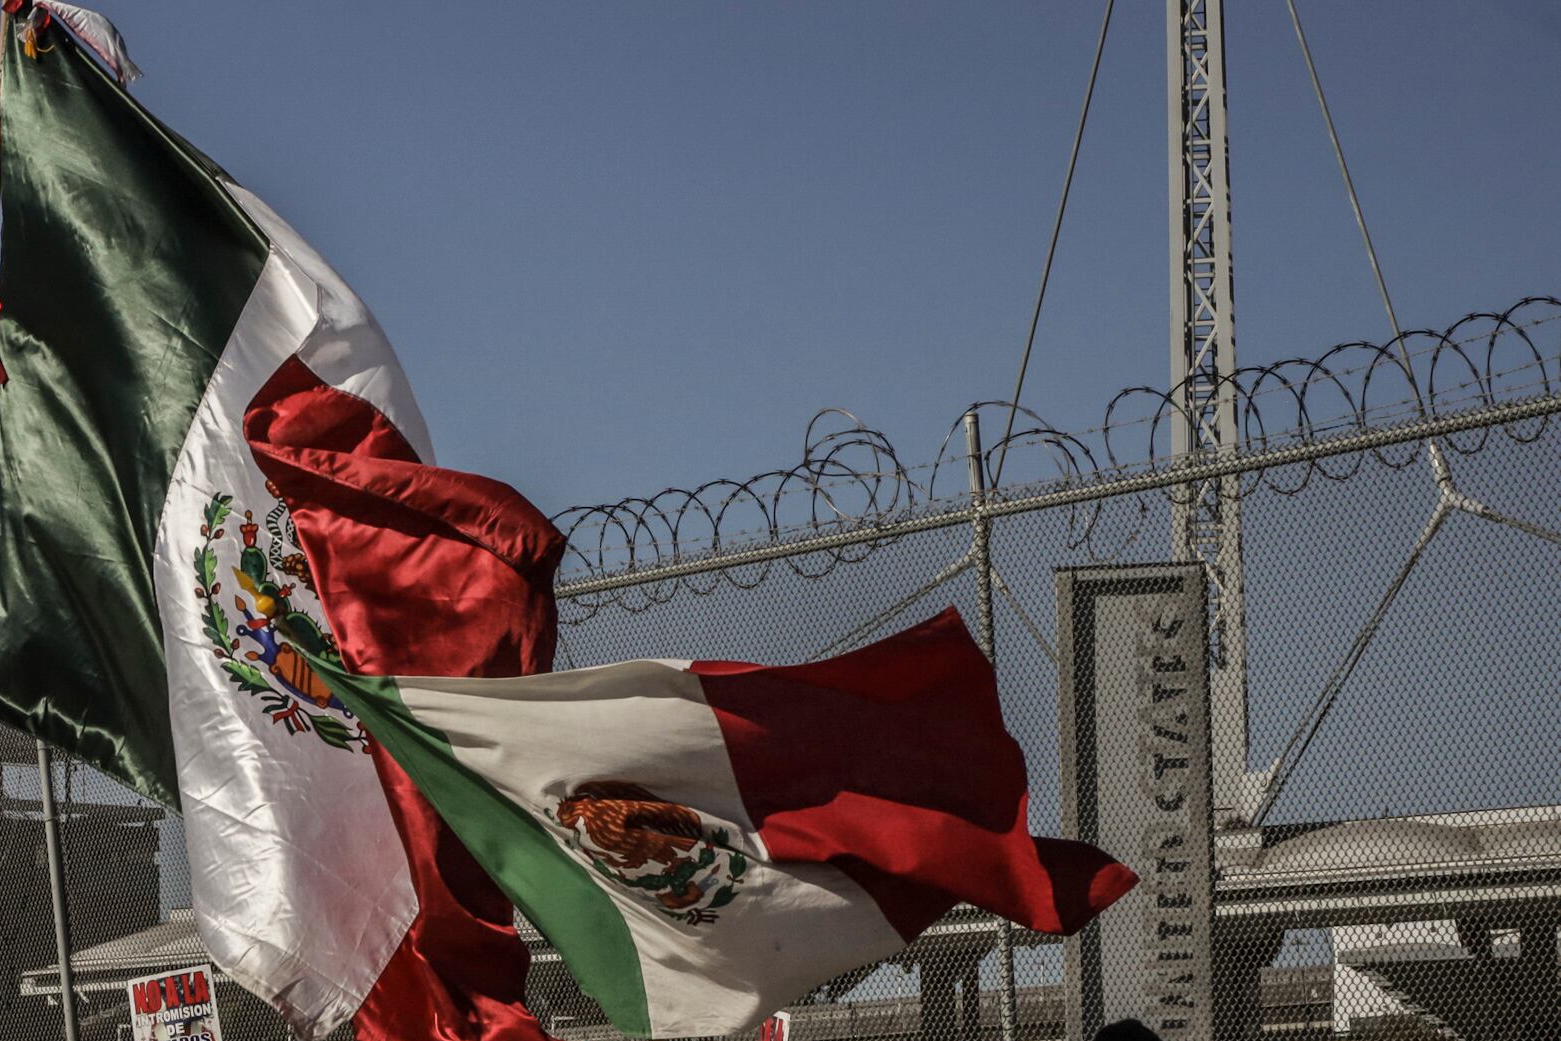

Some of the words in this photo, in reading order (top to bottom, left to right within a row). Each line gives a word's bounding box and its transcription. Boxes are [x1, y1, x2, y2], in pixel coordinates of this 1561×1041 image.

[133, 980, 162, 1014] NO
[181, 971, 210, 1004] LA
[137, 1004, 212, 1027] INTROMISION
[166, 1022, 185, 1036] DE
